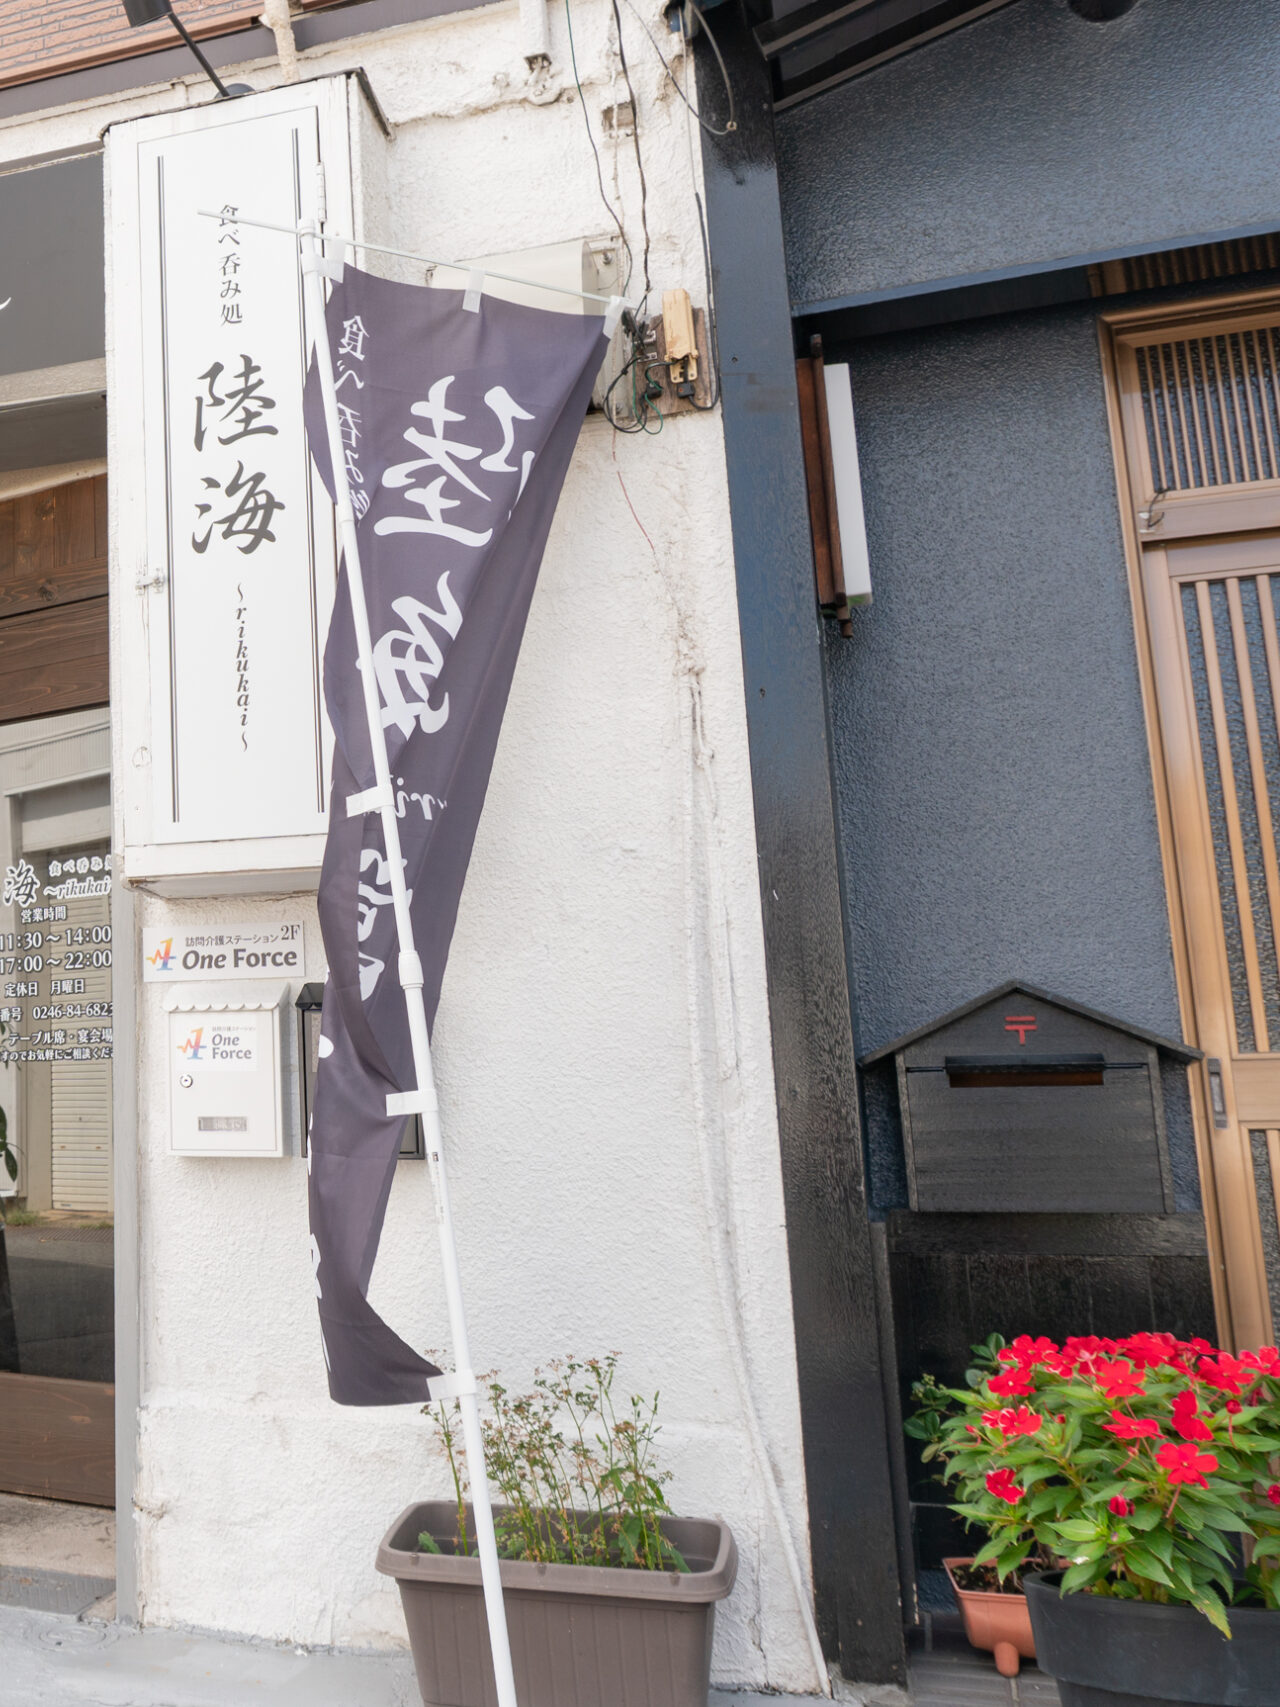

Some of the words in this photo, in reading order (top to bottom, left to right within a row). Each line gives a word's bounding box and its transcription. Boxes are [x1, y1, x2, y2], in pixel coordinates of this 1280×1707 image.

[218, 204, 243, 326] 食べ呑み処
[191, 354, 286, 555] 陸海
[21, 906, 67, 923] 営業時間
[185, 934, 279, 947] 訪問介護ステーション
[281, 925, 301, 941] 2F
[182, 950, 227, 969] One
[233, 949, 297, 968] Force
[4, 982, 38, 998] 定休日
[50, 979, 85, 995] 月曜日
[211, 1033, 240, 1046] One
[211, 1047, 252, 1060] Force
